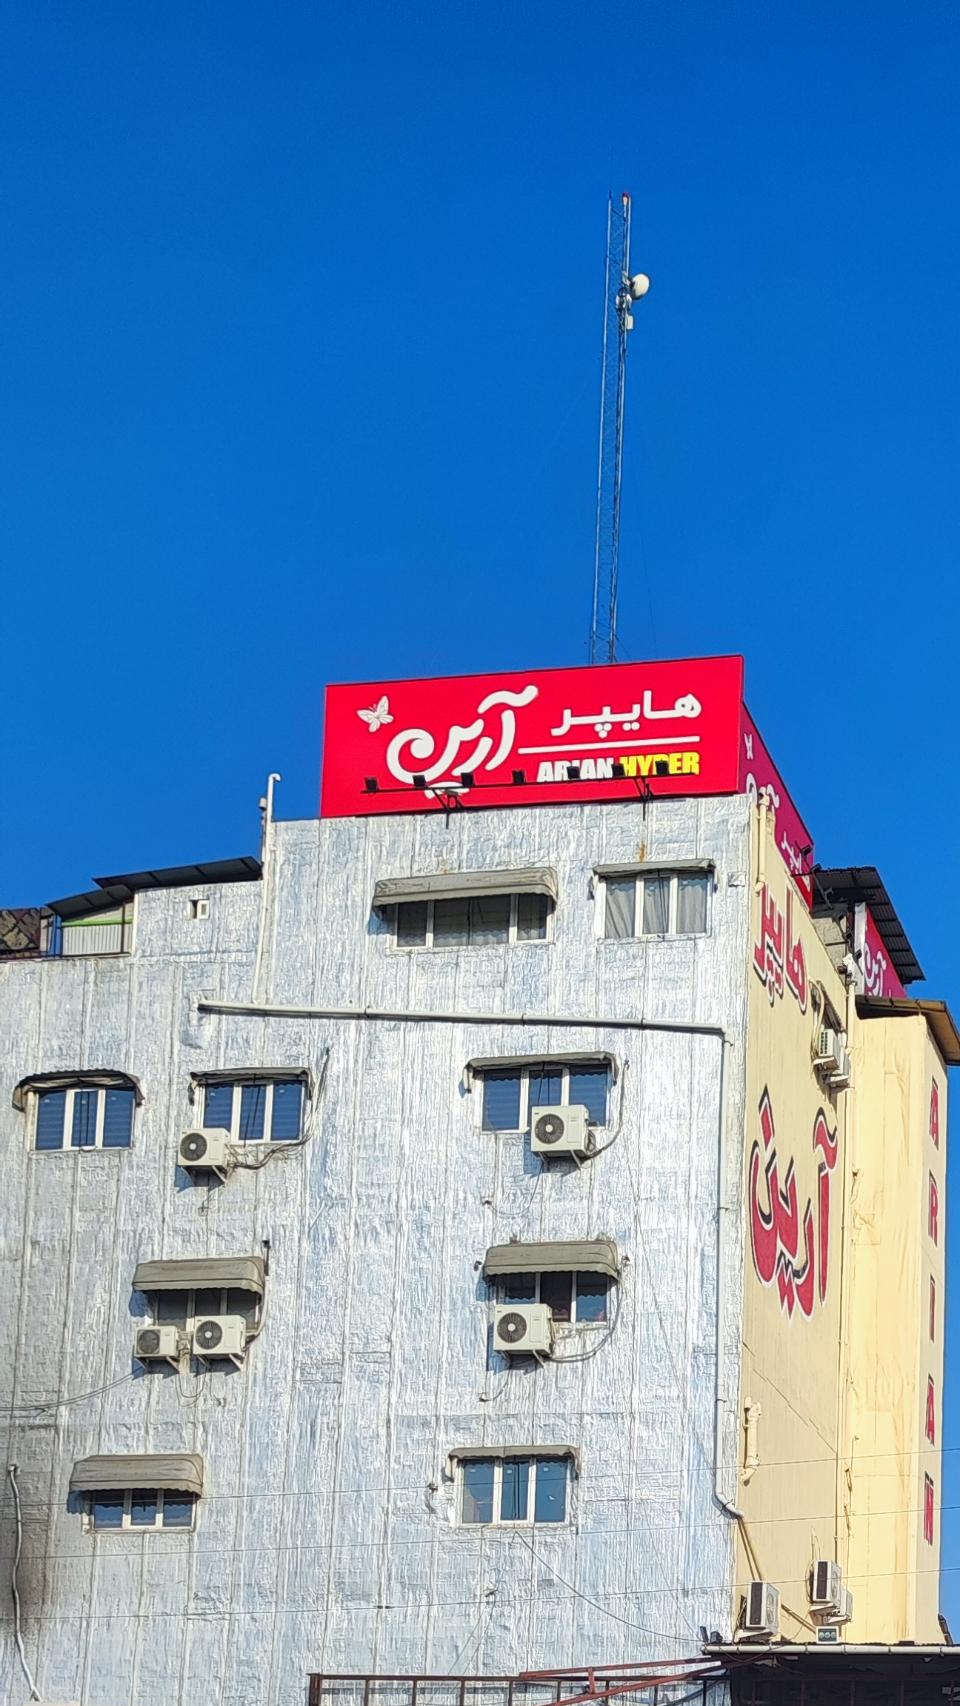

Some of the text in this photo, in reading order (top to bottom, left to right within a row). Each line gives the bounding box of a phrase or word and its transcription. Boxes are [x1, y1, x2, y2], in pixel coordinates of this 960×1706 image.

[550, 689, 702, 738] هایپر
[753, 882, 808, 1013] هایپر
[748, 1084, 839, 1321] آرین
